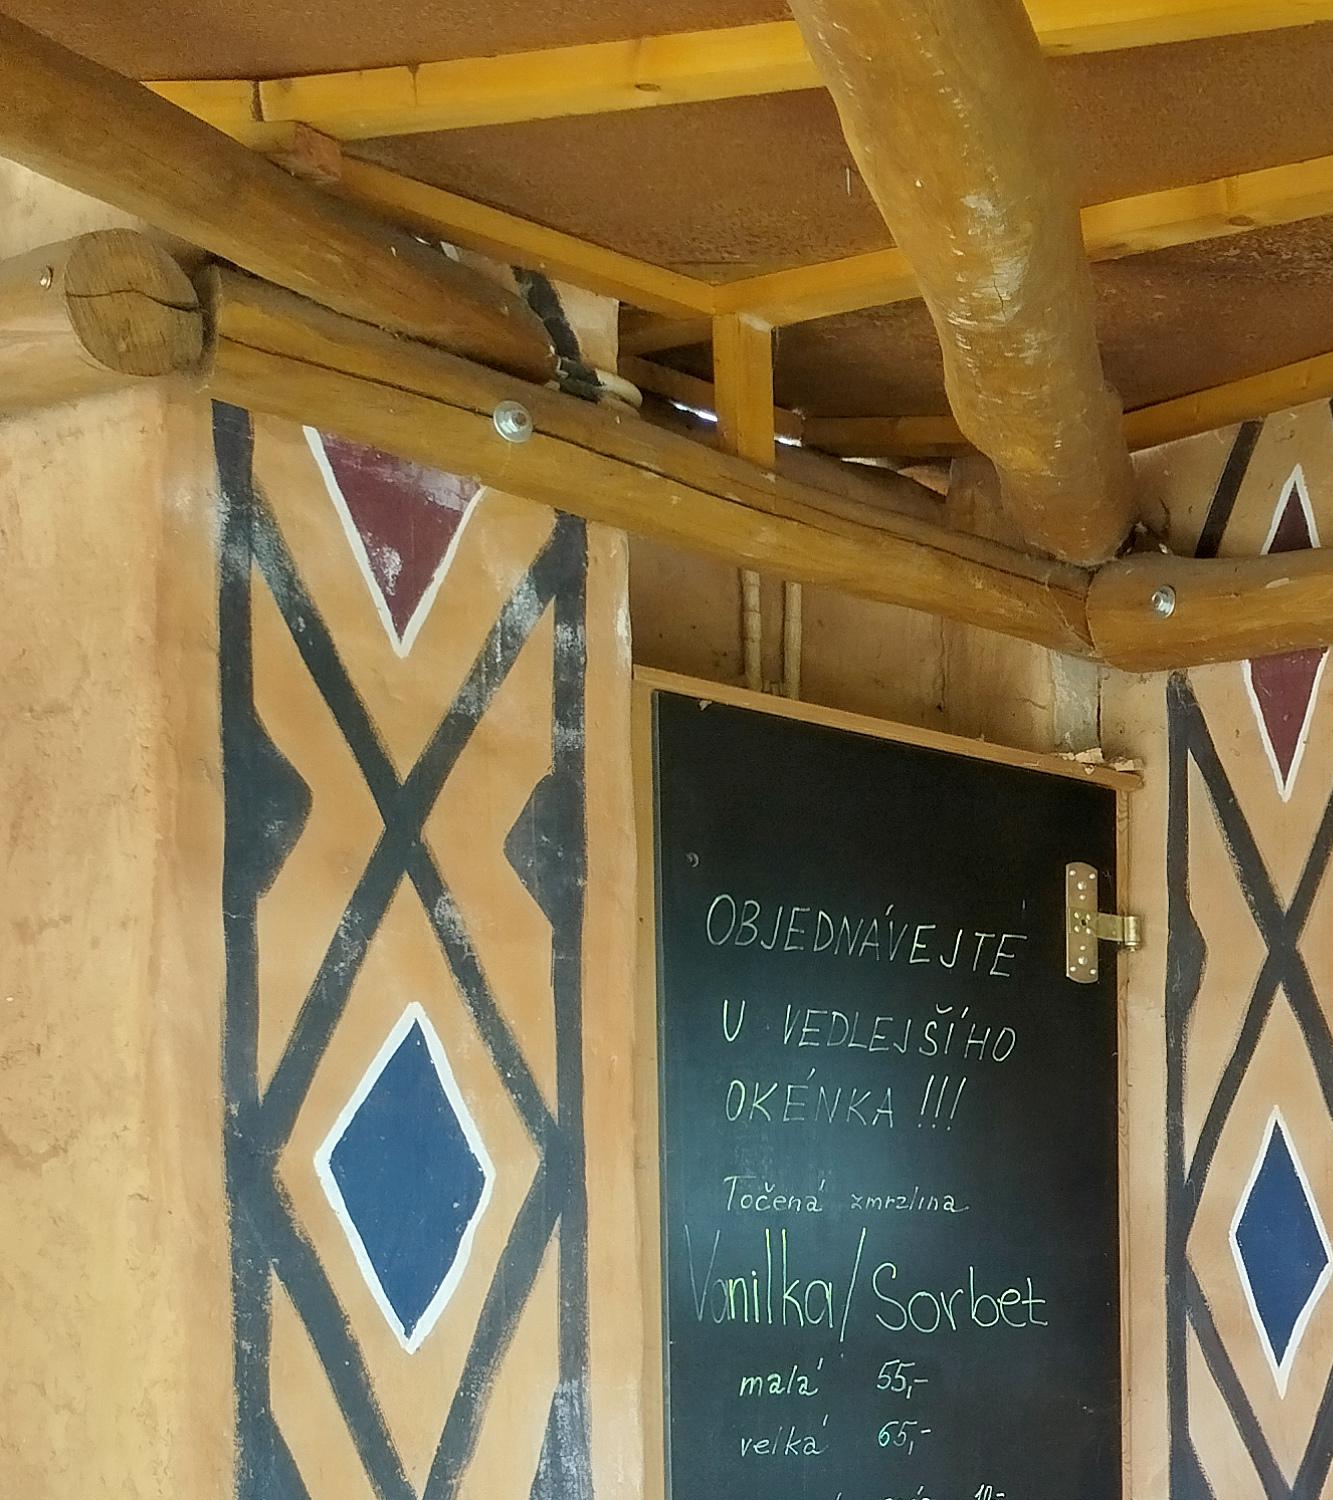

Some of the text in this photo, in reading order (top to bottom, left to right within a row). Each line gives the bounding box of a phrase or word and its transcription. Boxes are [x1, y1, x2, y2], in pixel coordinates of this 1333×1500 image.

[706, 894, 1027, 977] OBJEDNÁVEJTE
[723, 1000, 1016, 1062] U VEDLEJŠÍHO
[725, 1068, 966, 1130] OKÉNKA !!!
[723, 1176, 969, 1212] Točená zmrzlina
[739, 1358, 823, 1396] malá
[741, 1415, 828, 1456] velká
